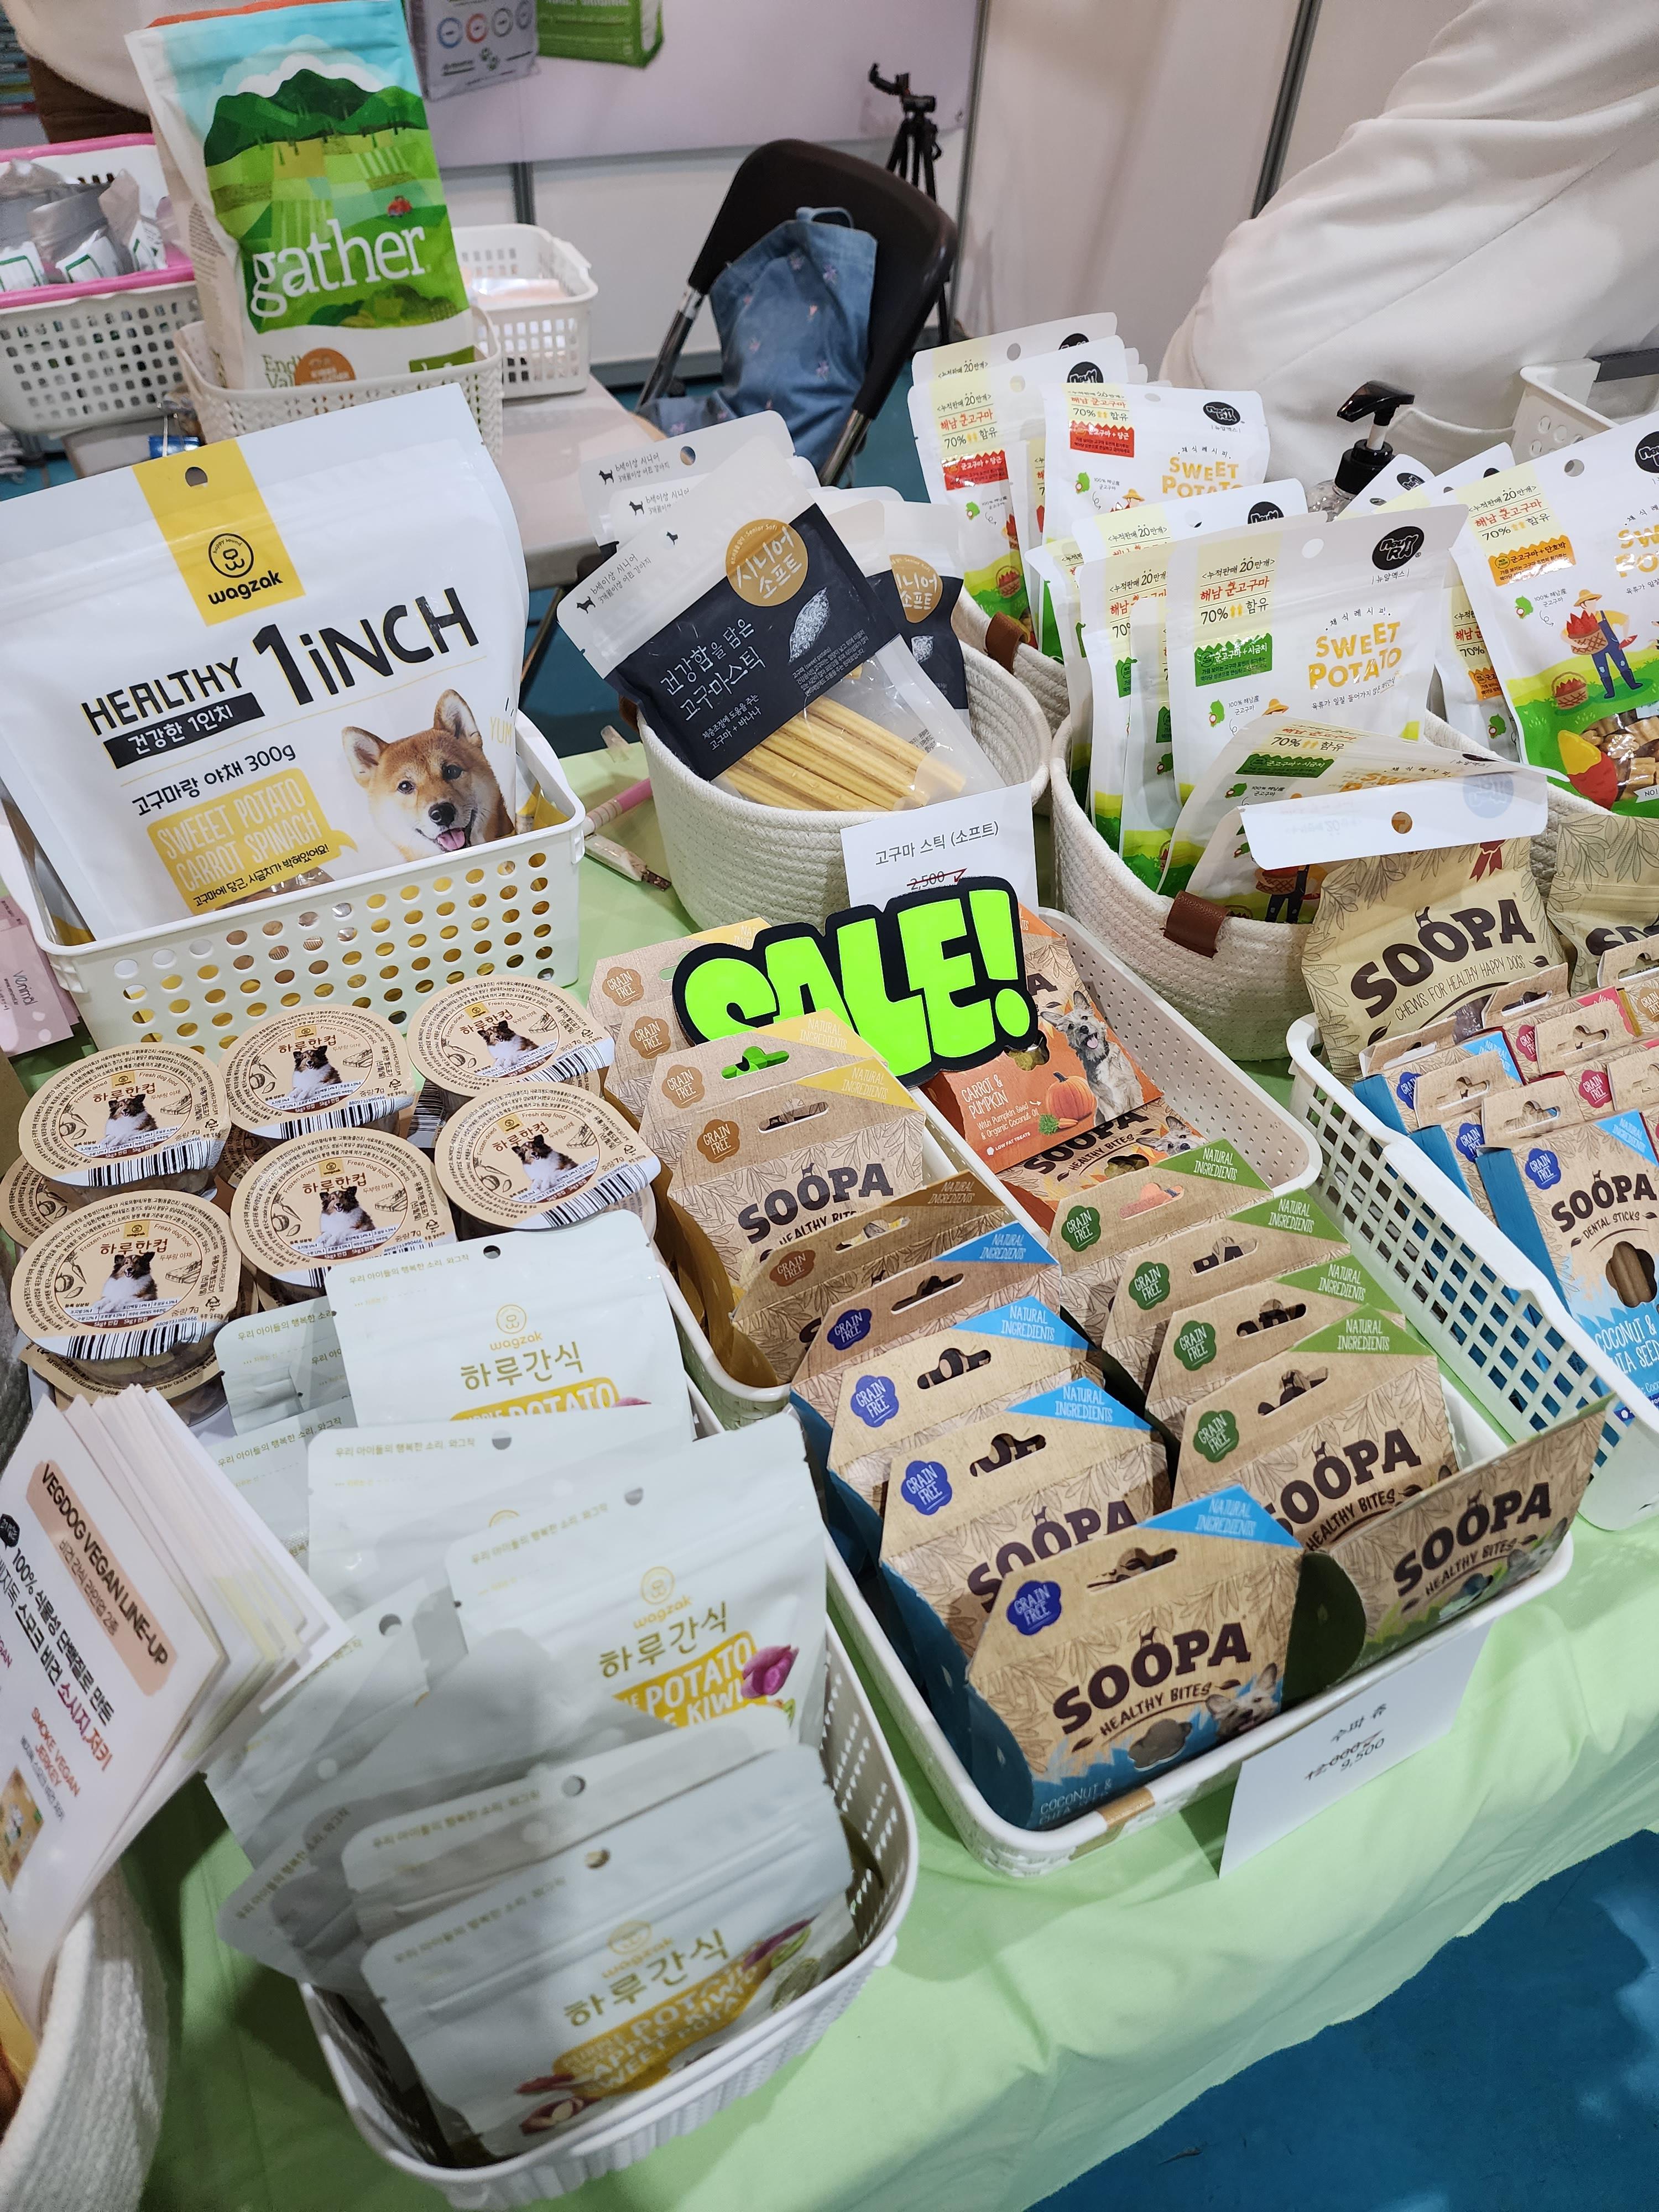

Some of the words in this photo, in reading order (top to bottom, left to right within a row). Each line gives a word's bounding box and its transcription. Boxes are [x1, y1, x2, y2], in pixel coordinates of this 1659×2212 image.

[251, 220, 427, 317] gather
[940, 419, 957, 431] 해남
[959, 409, 993, 427] 군고구마
[1073, 408, 1096, 418] 70%
[1110, 411, 1129, 421] 함유
[945, 435, 967, 448] 70%
[979, 427, 997, 440] 함유
[1170, 456, 1239, 481] SWEET
[1469, 497, 1502, 512] <누적판매
[1475, 514, 1497, 528] 해남
[1499, 499, 1542, 520] 군고구마
[1481, 526, 1511, 541] 70%
[1526, 513, 1550, 526] 함유
[616, 553, 638, 573] 시니어
[737, 526, 795, 589] 시니어
[208, 571, 283, 604] wagzak
[759, 554, 802, 599] 소프트
[1202, 568, 1237, 579] <누적판매
[1200, 588, 1222, 601] 해남
[1225, 576, 1270, 597] 군고구마
[1543, 597, 1563, 607] 군고구마
[1200, 607, 1228, 625] 70%
[1245, 598, 1269, 613] 함유
[1316, 622, 1400, 659] SWEET
[660, 641, 727, 696] 건강함을
[723, 618, 755, 650] 담은
[1308, 648, 1402, 690] POTATO
[81, 657, 242, 736] HEALTHY
[680, 646, 766, 721] 고구마스틱
[702, 715, 731, 740] 체중조절에
[730, 703, 747, 721] 도움을
[745, 694, 760, 707] 주는
[1235, 705, 1254, 716] 군고구마
[128, 722, 185, 755] 건강한
[187, 705, 233, 732] 1인치
[709, 730, 734, 750] 고구마
[738, 706, 762, 727] 바나나
[132, 778, 200, 816] 고구마랑
[205, 760, 244, 785] 야채
[245, 744, 296, 773] 300g
[233, 778, 306, 828] POTATO
[176, 842, 245, 891] CARROT
[244, 810, 322, 864] SPINACH
[875, 843, 916, 867] 고구마
[920, 834, 947, 854] 스틱
[950, 821, 999, 849] (소프트)
[193, 888, 227, 906] 고구마에
[249, 863, 282, 885] 시금치가
[1350, 899, 1536, 1019] SOOPA
[607, 971, 632, 991] GRAIN
[616, 983, 636, 1000] FREE
[684, 889, 1031, 1079] SALE!
[1395, 994, 1430, 1021] CHEWS
[1428, 982, 1448, 1002] FOR
[1448, 965, 1479, 993] HEALTHY
[1479, 956, 1506, 977] HAPPY
[1509, 954, 1526, 971] DOGS
[459, 1009, 514, 1035] 하루한컵
[278, 1035, 337, 1053] 하루한컵
[74, 1086, 93, 1103] Frozen
[91, 1081, 108, 1091] dried
[93, 1082, 156, 1103] 하루한컵
[156, 1074, 168, 1083] dog
[166, 1077, 179, 1087] food
[961, 1077, 993, 1103] CARROT
[993, 1074, 1004, 1088] &
[968, 1089, 1009, 1119] PUMPKIN
[977, 1118, 992, 1131] With
[992, 1106, 1020, 1126] Pumpkin
[1019, 1102, 1029, 1115] Seed
[190, 1129, 201, 1138] 7g
[492, 1121, 550, 1152] 하루한컵
[703, 1124, 731, 1146] GRAIN
[986, 1123, 1009, 1139] Organic
[1008, 1113, 1032, 1129] Coconut
[711, 1138, 732, 1156] FREE
[995, 1142, 1006, 1151] LOW
[1005, 1139, 1014, 1147] FAT
[1014, 1131, 1031, 1144] TREATS
[1068, 1145, 1104, 1172] HEALTHY
[1105, 1134, 1135, 1151] BITES
[1193, 1159, 1238, 1181] INGREDIENTS
[1202, 1147, 1234, 1165] NATURAL
[1530, 1154, 1552, 1173] GRAIN
[302, 1172, 367, 1194] 하루한컵
[1537, 1166, 1554, 1181] FREE
[738, 1164, 894, 1244] SOOPA
[1551, 1172, 1657, 1233] SOOPA
[1065, 1211, 1093, 1235] GRAIN
[1073, 1224, 1094, 1243] FREE
[1583, 1217, 1611, 1239] DENTAL
[1613, 1212, 1640, 1223] STICKS
[100, 1238, 169, 1255] 하루한컵
[349, 1274, 366, 1285] 우리
[367, 1266, 399, 1281] 아이들의
[401, 1261, 425, 1275] 행복한
[1009, 1305, 1048, 1324] NATURAL
[1344, 1318, 1384, 1335] NATURAL
[489, 1331, 543, 1352] wagzak
[1000, 1321, 1055, 1342] INGREDIENTS
[1178, 1326, 1209, 1352] GRAIN
[1337, 1333, 1391, 1351] INGREDIENTS
[1595, 1318, 1645, 1354] COCONUT
[1645, 1314, 1657, 1335] &
[460, 1341, 584, 1390] 하루간식
[1187, 1342, 1209, 1361] FREE
[855, 1379, 886, 1407] GRAIN
[866, 1395, 890, 1418] FREE
[1197, 1416, 1228, 1444] GRAIN
[1207, 1434, 1230, 1452] FREE
[1306, 1503, 1357, 1552] HEALTHY
[1358, 1489, 1396, 1515] BITES
[1393, 1481, 1552, 1598] SOOPA
[42, 1464, 86, 1541] VEGDOG
[83, 1532, 125, 1601] VEGAN
[118, 1592, 168, 1665] LINE-UP
[1425, 1553, 1477, 1597] HEALTHY
[1482, 1538, 1517, 1560] BITES
[632, 1595, 693, 1629] wagzak
[12, 1548, 38, 1595] 100%
[35, 1589, 61, 1636] 식물성
[90, 1686, 114, 1726] 만든
[15, 1603, 45, 1654] 스모크
[40, 1644, 63, 1687] 비건
[599, 1600, 729, 1681] 하루간식
[645, 1637, 755, 1717] POTATO
[1052, 1621, 1252, 1735] SOOPA
[1099, 1693, 1165, 1738] HEALTHY
[1170, 1682, 1212, 1708] BITES
[31, 1706, 57, 1752] SMOKE
[55, 1748, 80, 1797] VEGAN
[1338, 1737, 1386, 1772] 9,500
[563, 1928, 728, 2027] 하루간식
